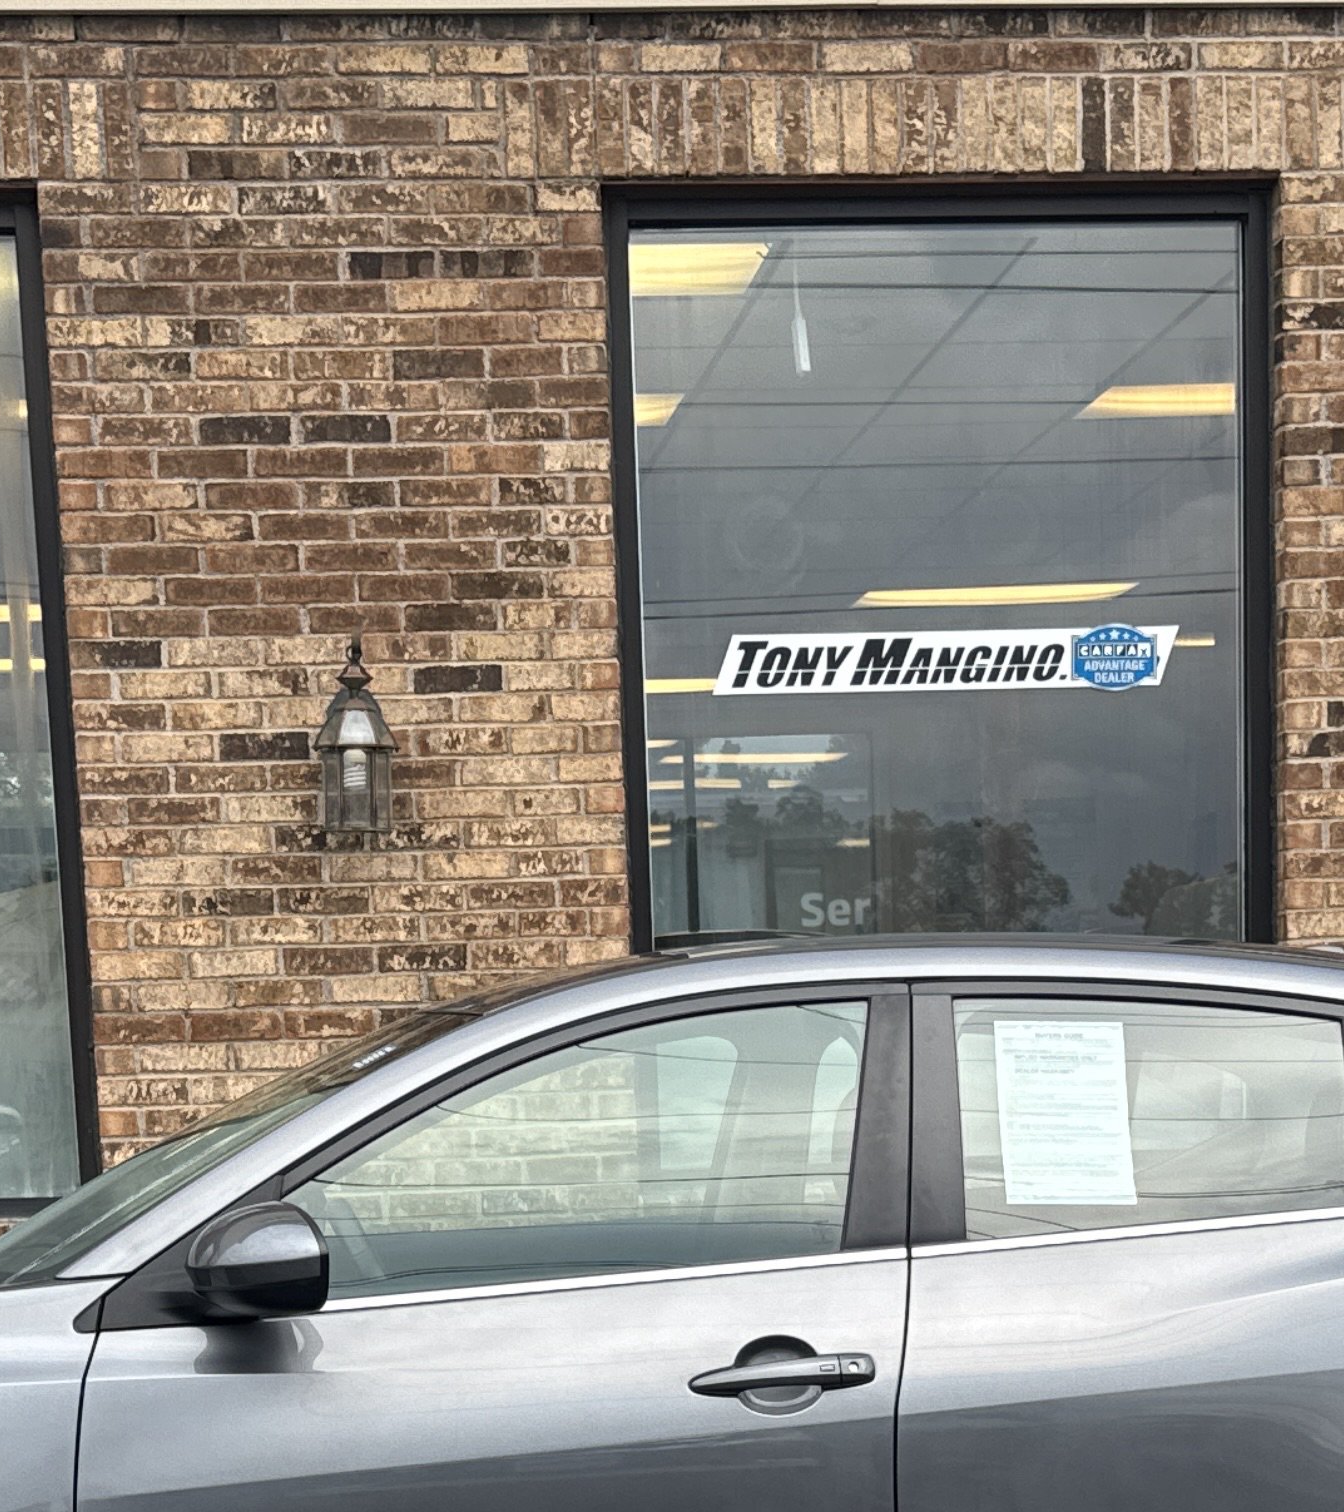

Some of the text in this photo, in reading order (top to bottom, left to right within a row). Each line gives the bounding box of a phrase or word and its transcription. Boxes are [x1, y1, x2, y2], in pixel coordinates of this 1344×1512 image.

[1078, 643, 1152, 658] CARFAX
[732, 641, 854, 688] TONY
[1084, 659, 1146, 671] ADVANTAGE
[1094, 672, 1135, 684] DEALER
[800, 892, 872, 927] Ser
